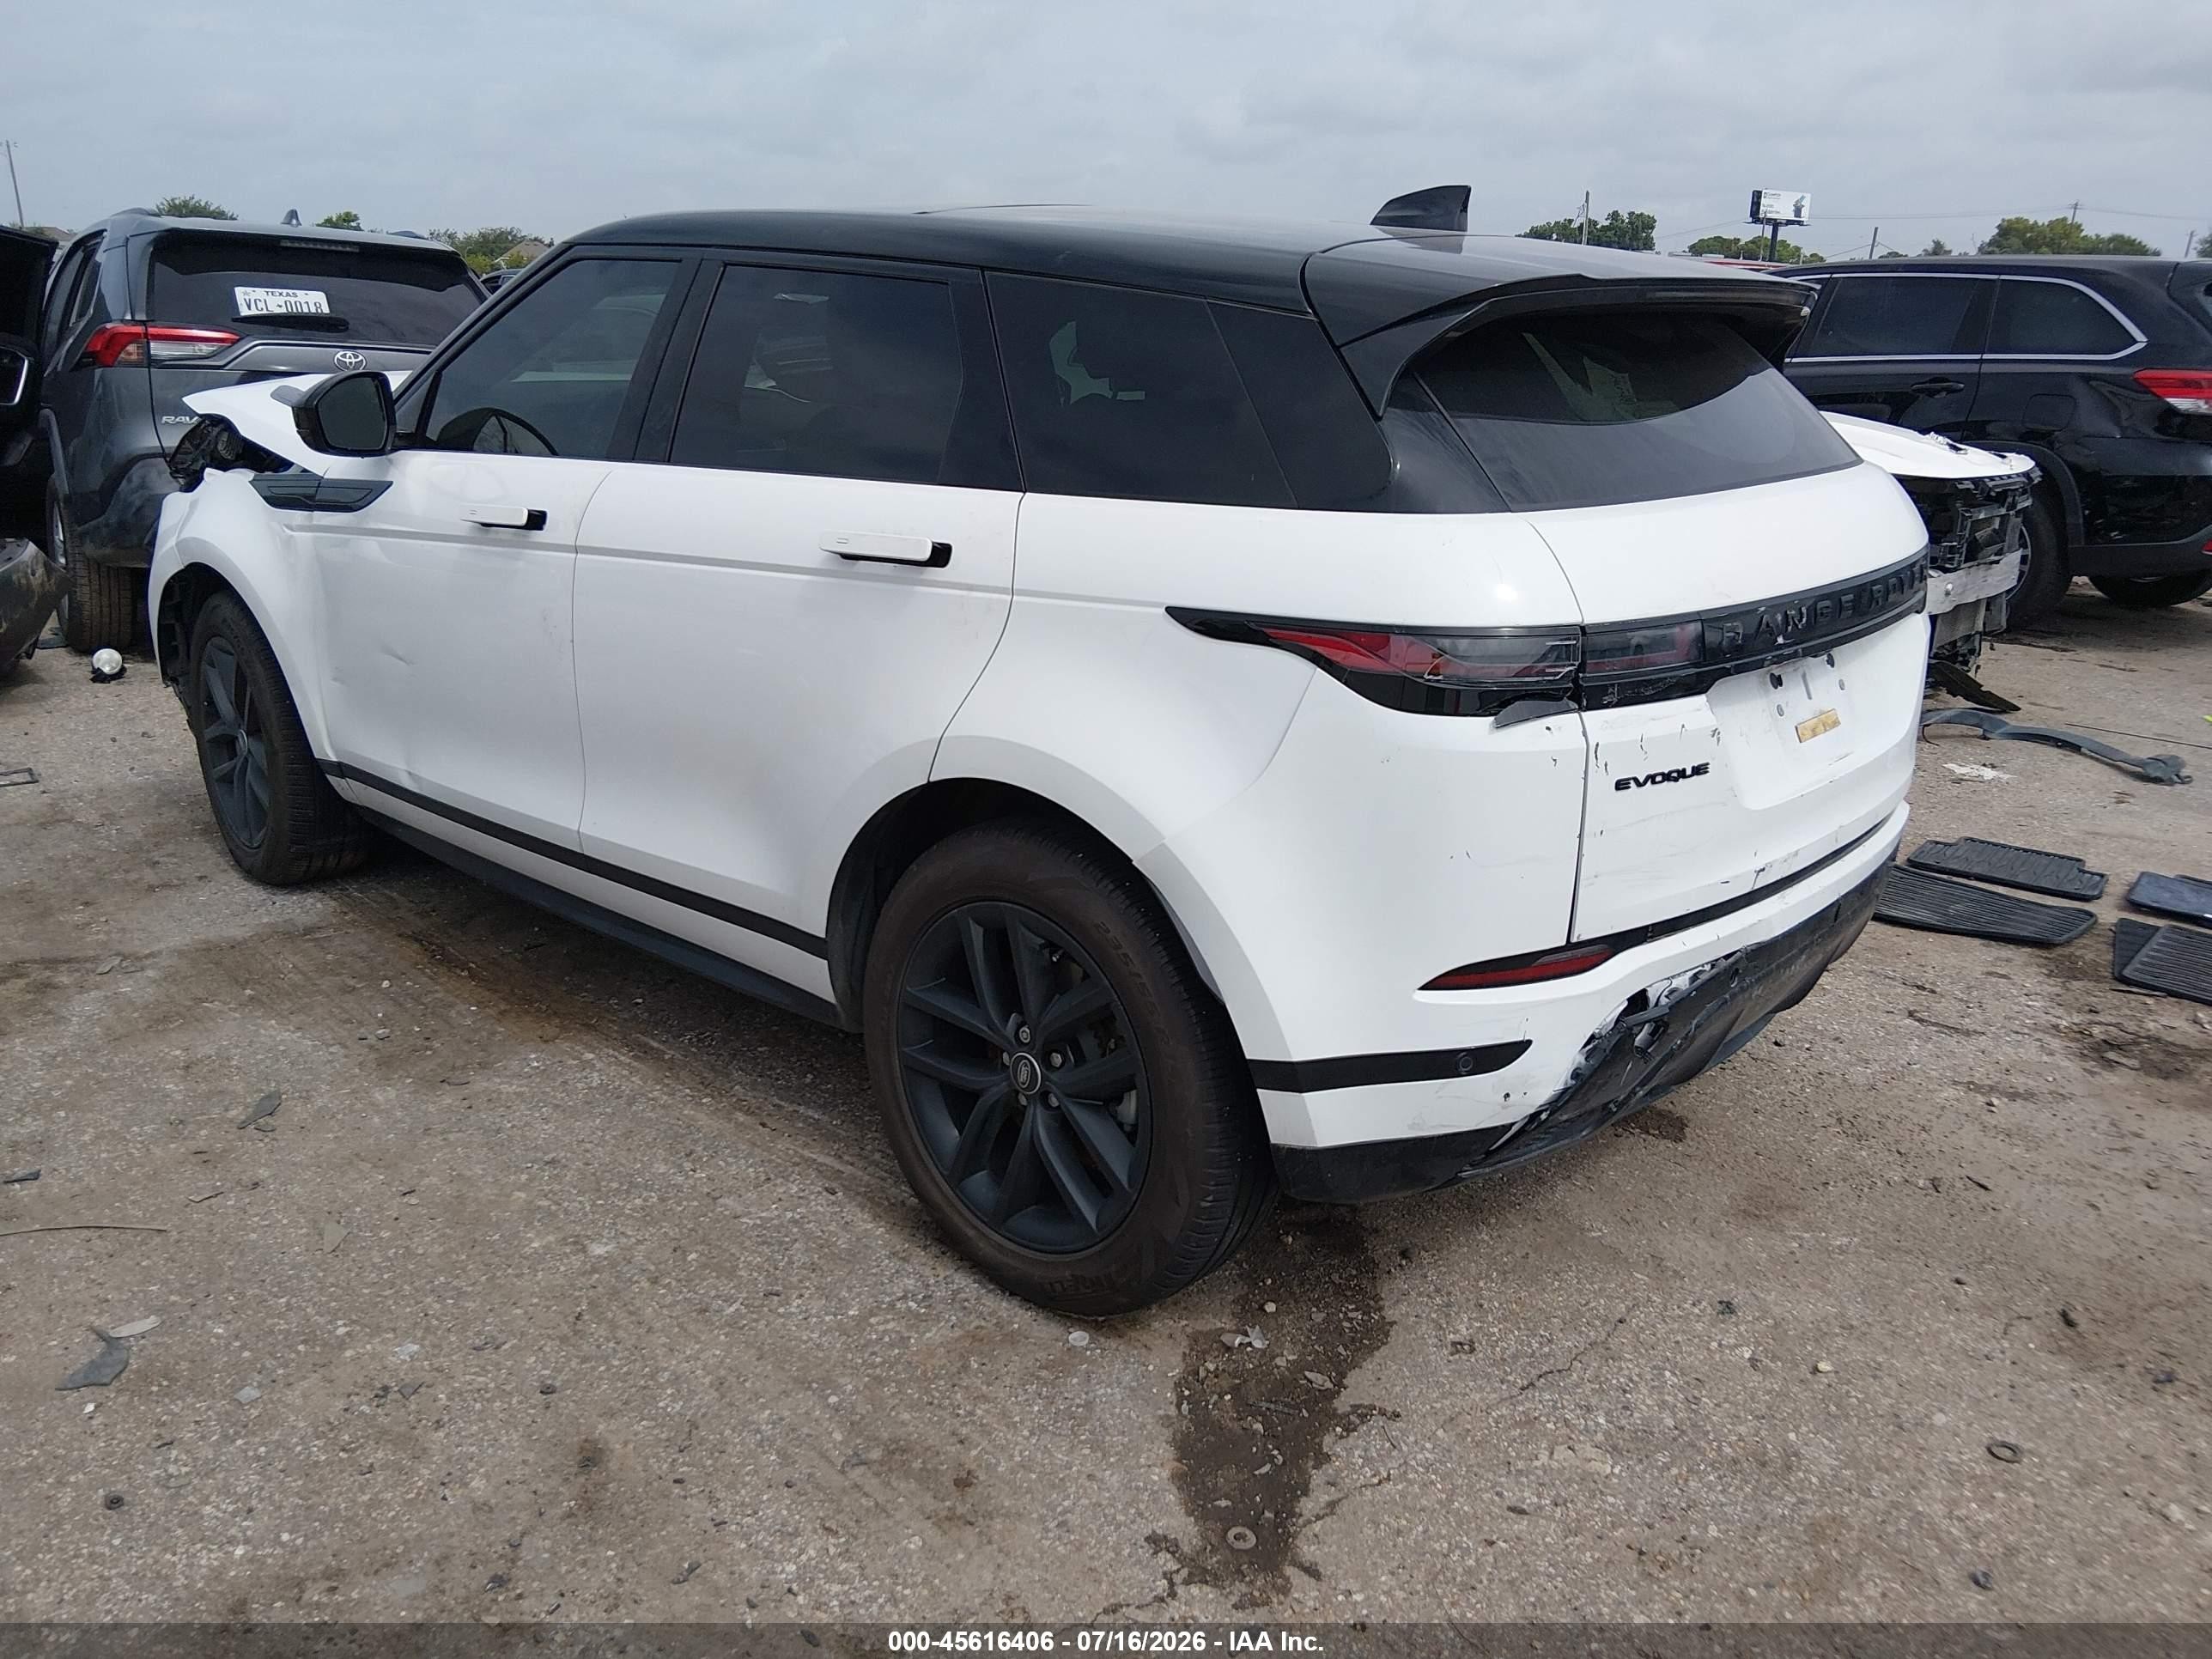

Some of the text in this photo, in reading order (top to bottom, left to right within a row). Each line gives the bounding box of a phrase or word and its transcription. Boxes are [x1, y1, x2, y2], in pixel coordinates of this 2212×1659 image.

[161, 416, 202, 424] RAV
[1721, 592, 1856, 647] RANGE
[1614, 762, 1711, 792] EVOQUE
